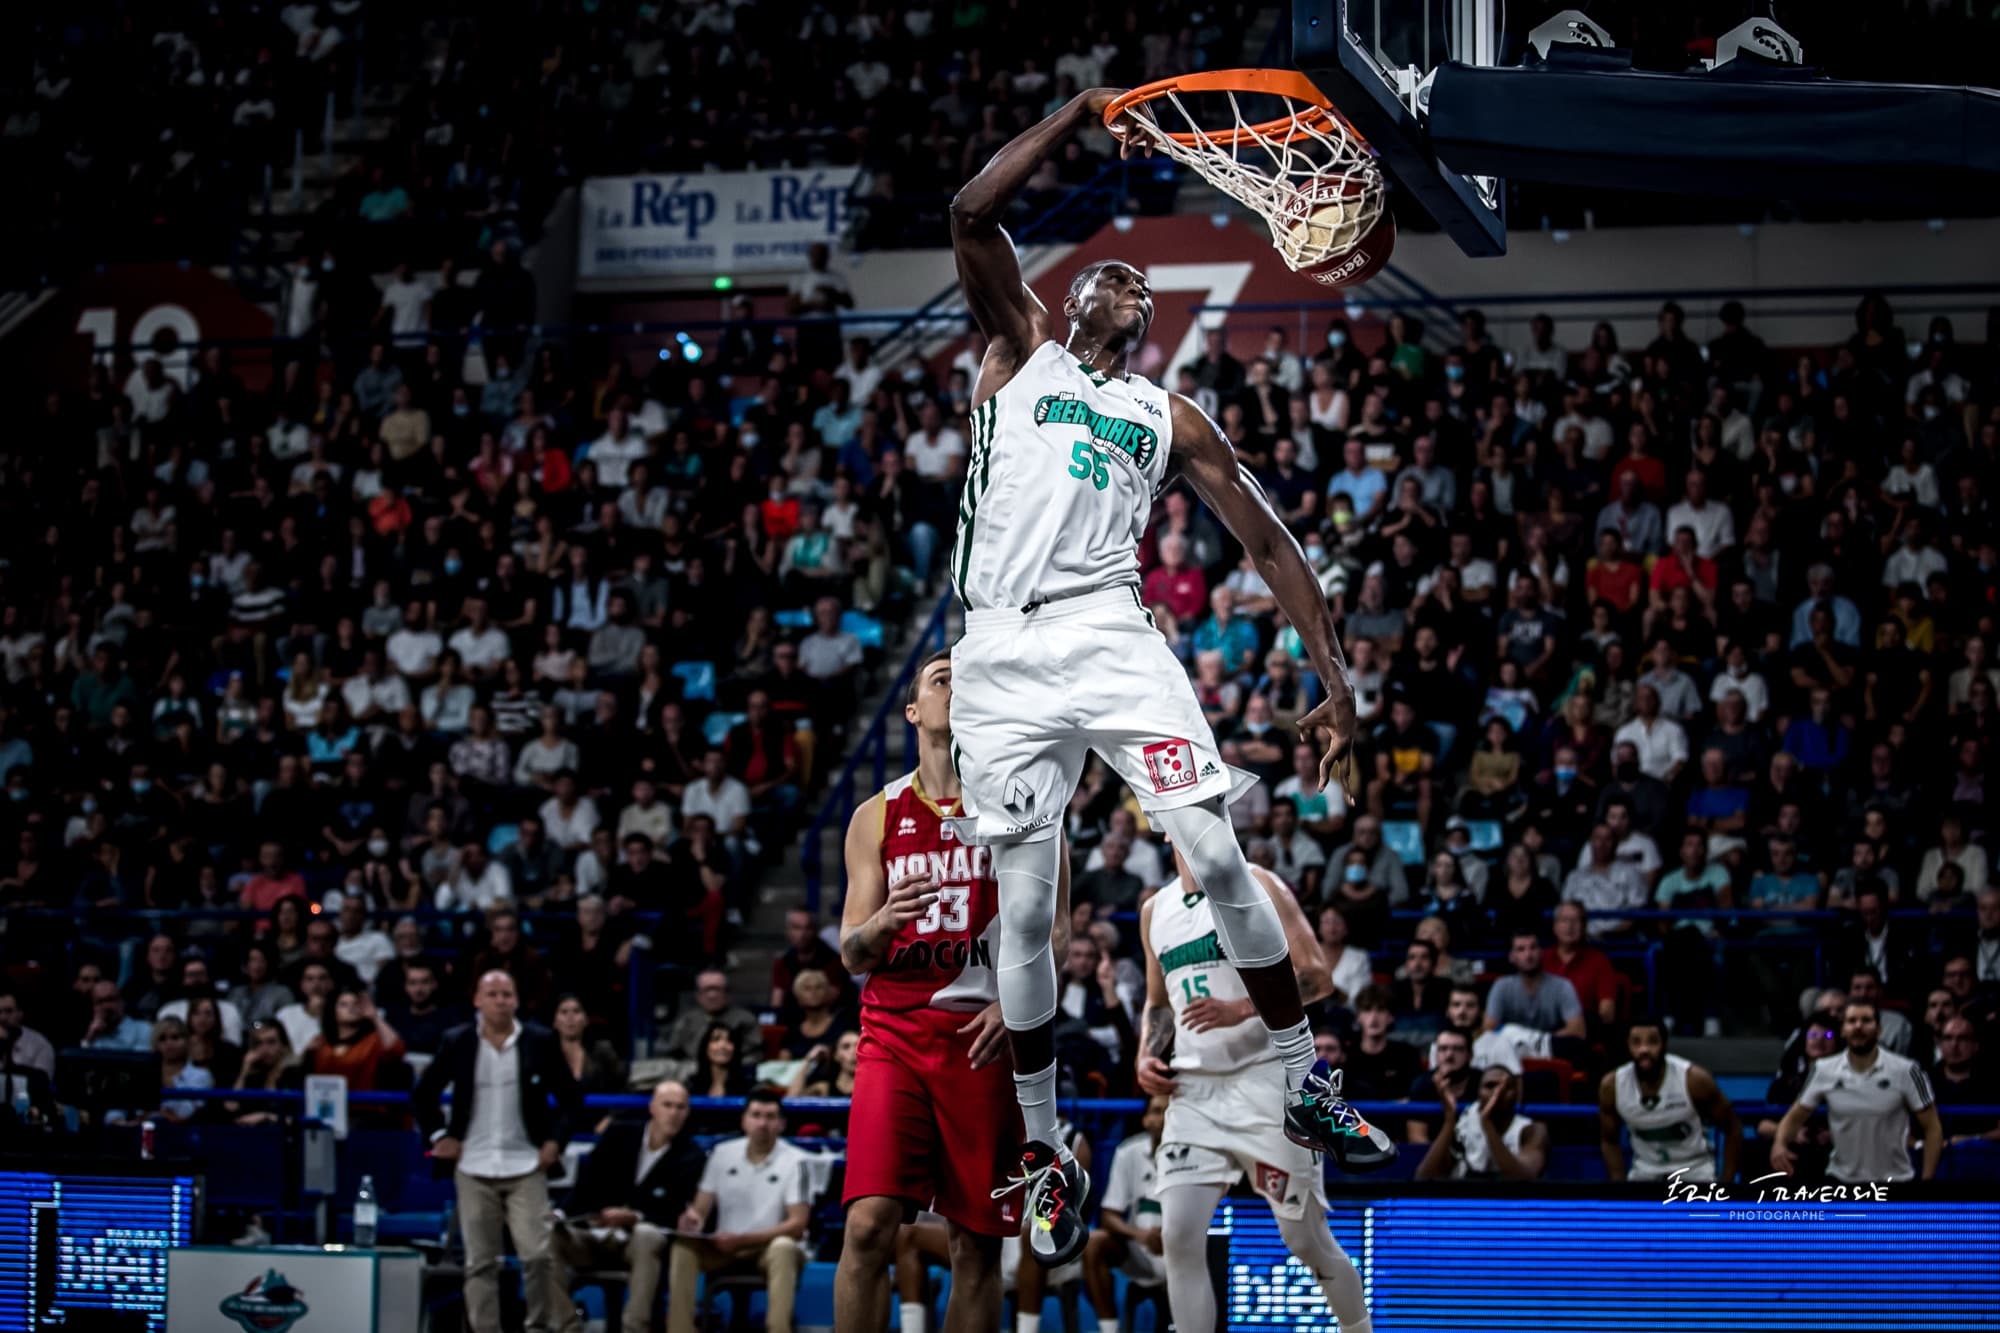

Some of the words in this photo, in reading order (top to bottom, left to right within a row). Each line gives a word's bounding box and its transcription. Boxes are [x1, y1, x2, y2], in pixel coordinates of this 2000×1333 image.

[631, 176, 716, 241] Rép
[770, 171, 853, 234] Rép
[1317, 253, 1366, 284] Betclic
[1146, 262, 1254, 392] 7
[1068, 440, 1110, 491] 55
[886, 845, 999, 888] MONAC
[1181, 974, 1211, 1005] 15
